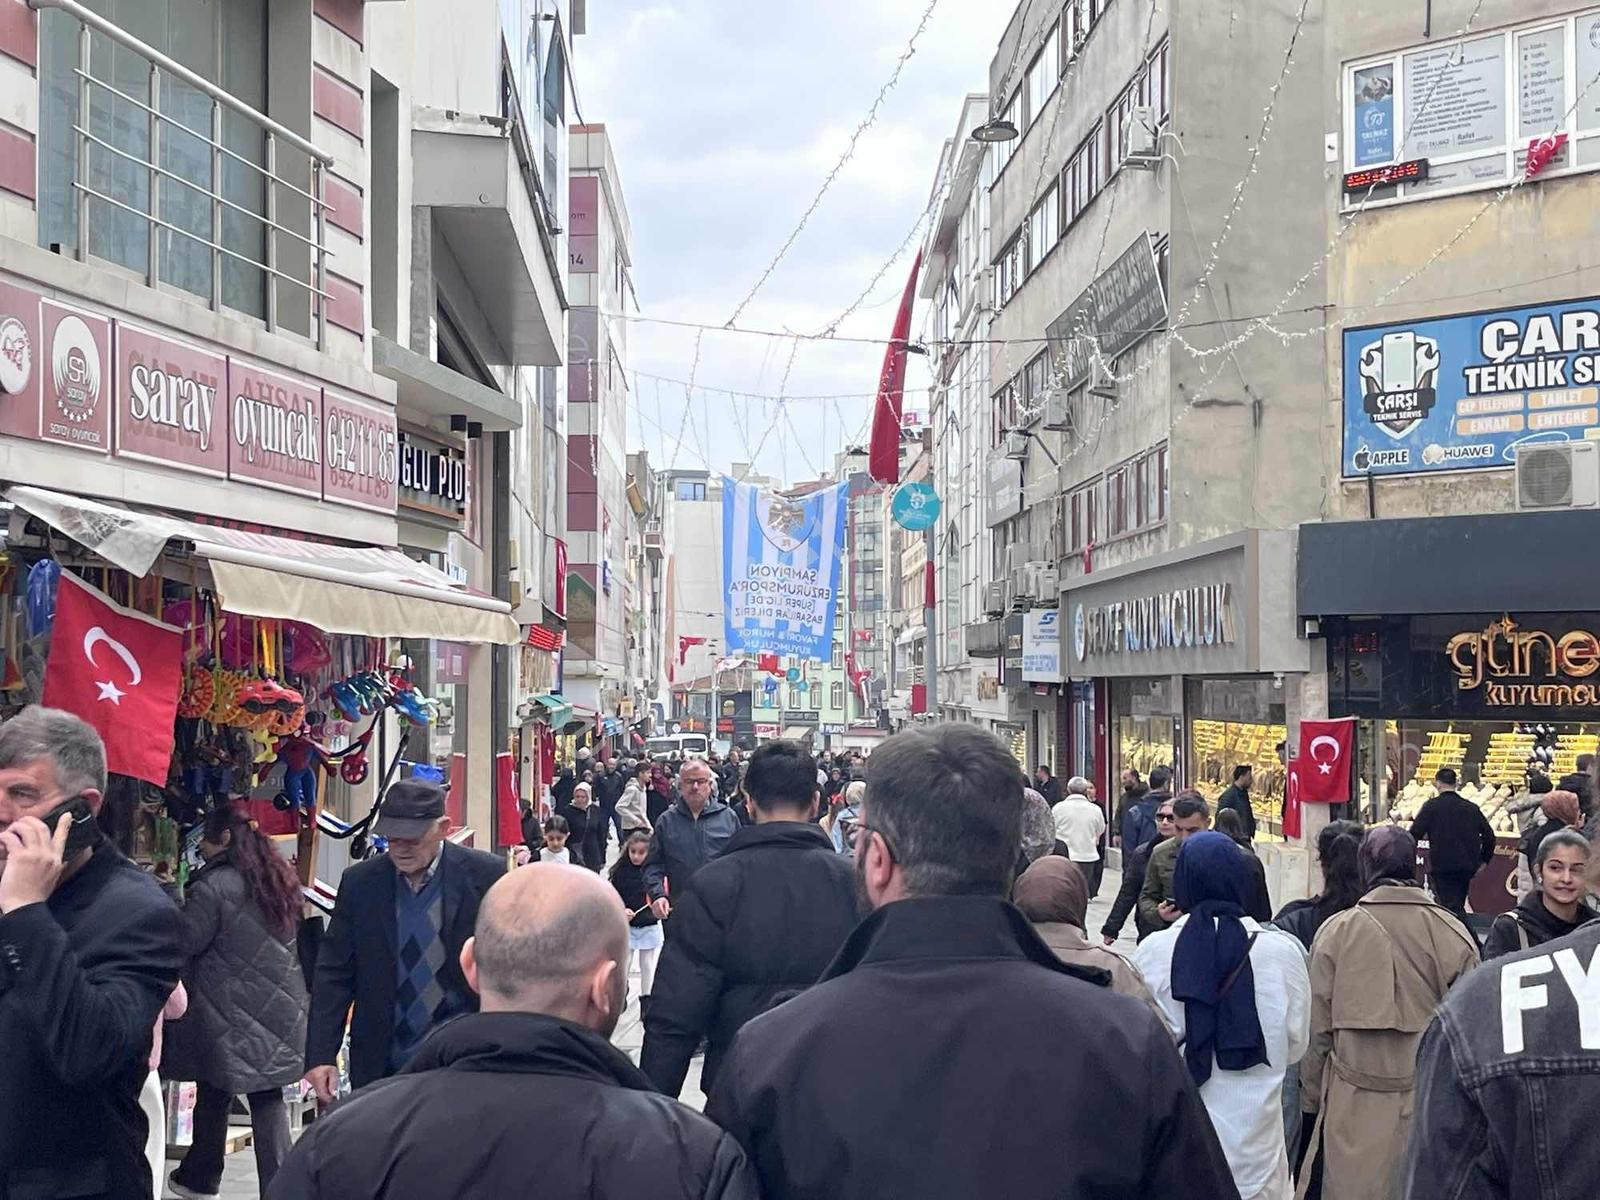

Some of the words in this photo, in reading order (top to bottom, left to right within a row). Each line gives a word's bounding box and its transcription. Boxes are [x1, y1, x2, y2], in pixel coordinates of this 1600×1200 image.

[570, 253, 584, 265] 14
[1464, 355, 1567, 394] TEKNİK
[130, 363, 217, 452] saray
[1376, 392, 1419, 413] ÇARŞI
[50, 422, 70, 440] saray
[233, 394, 320, 464] oyuncak
[396, 432, 431, 492] ĞLU
[1373, 450, 1408, 465] APPLE
[1443, 445, 1494, 460] HUAWEI
[1124, 582, 1235, 652] KUYUMCULUK
